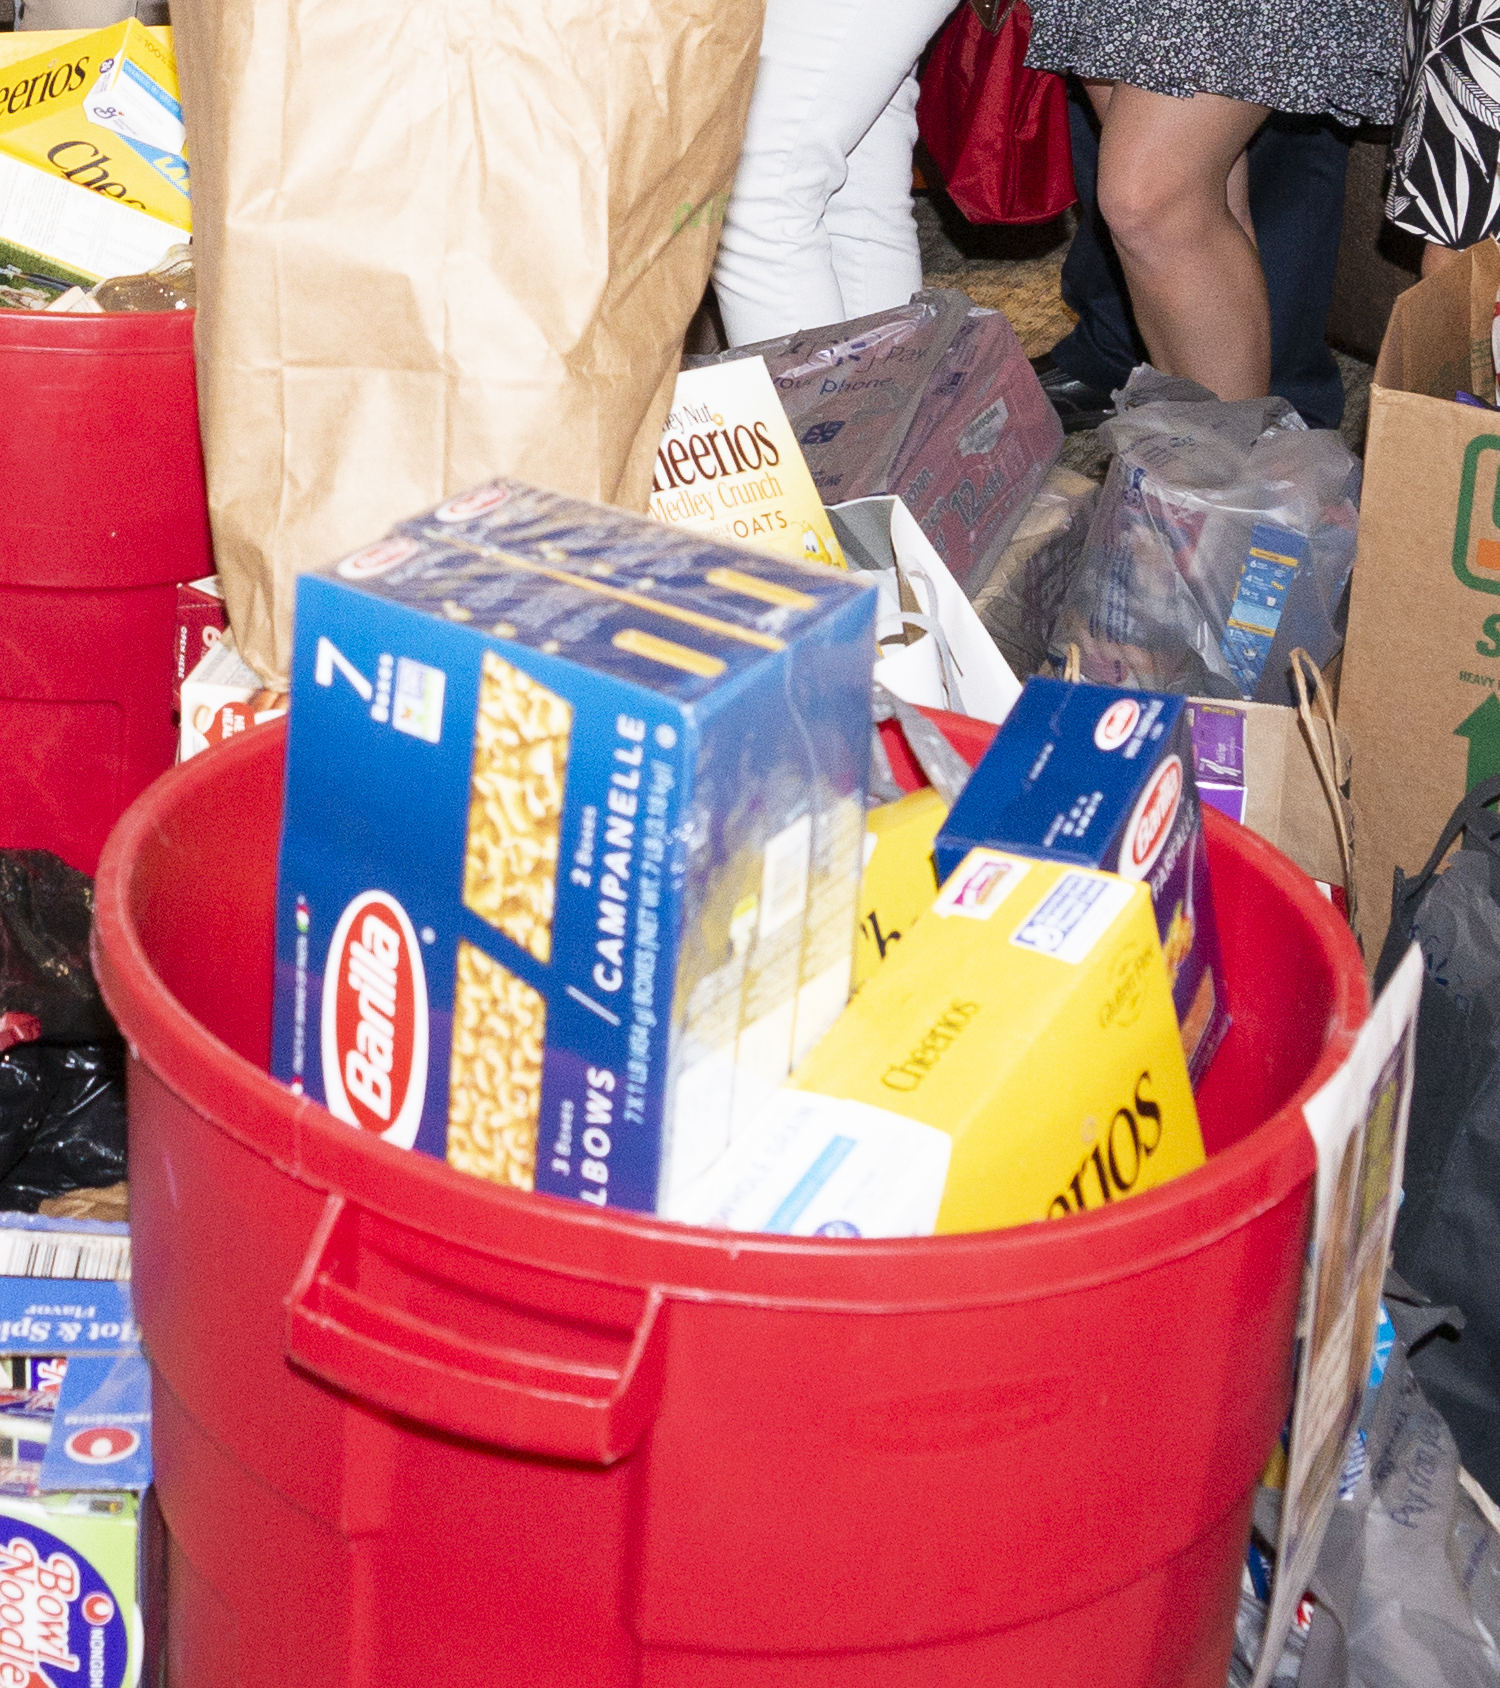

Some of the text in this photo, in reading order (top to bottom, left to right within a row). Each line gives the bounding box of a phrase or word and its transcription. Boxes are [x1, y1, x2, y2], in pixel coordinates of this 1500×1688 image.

[685, 403, 712, 426] Nut
[650, 474, 783, 525] Medley Crunch
[734, 510, 788, 539] OATS
[178, 625, 188, 653] OPEN
[314, 636, 373, 701] 7
[371, 653, 394, 723] Boxes
[1459, 670, 1495, 689] HEAVY
[574, 806, 597, 887] 2 Boxes
[592, 714, 647, 993] CAMPANELLE
[346, 914, 400, 1121] Barilla
[883, 1000, 979, 1094] Cheerios
[552, 1100, 575, 1177] 3 Boxes
[36, 1551, 81, 1672] Bowl
